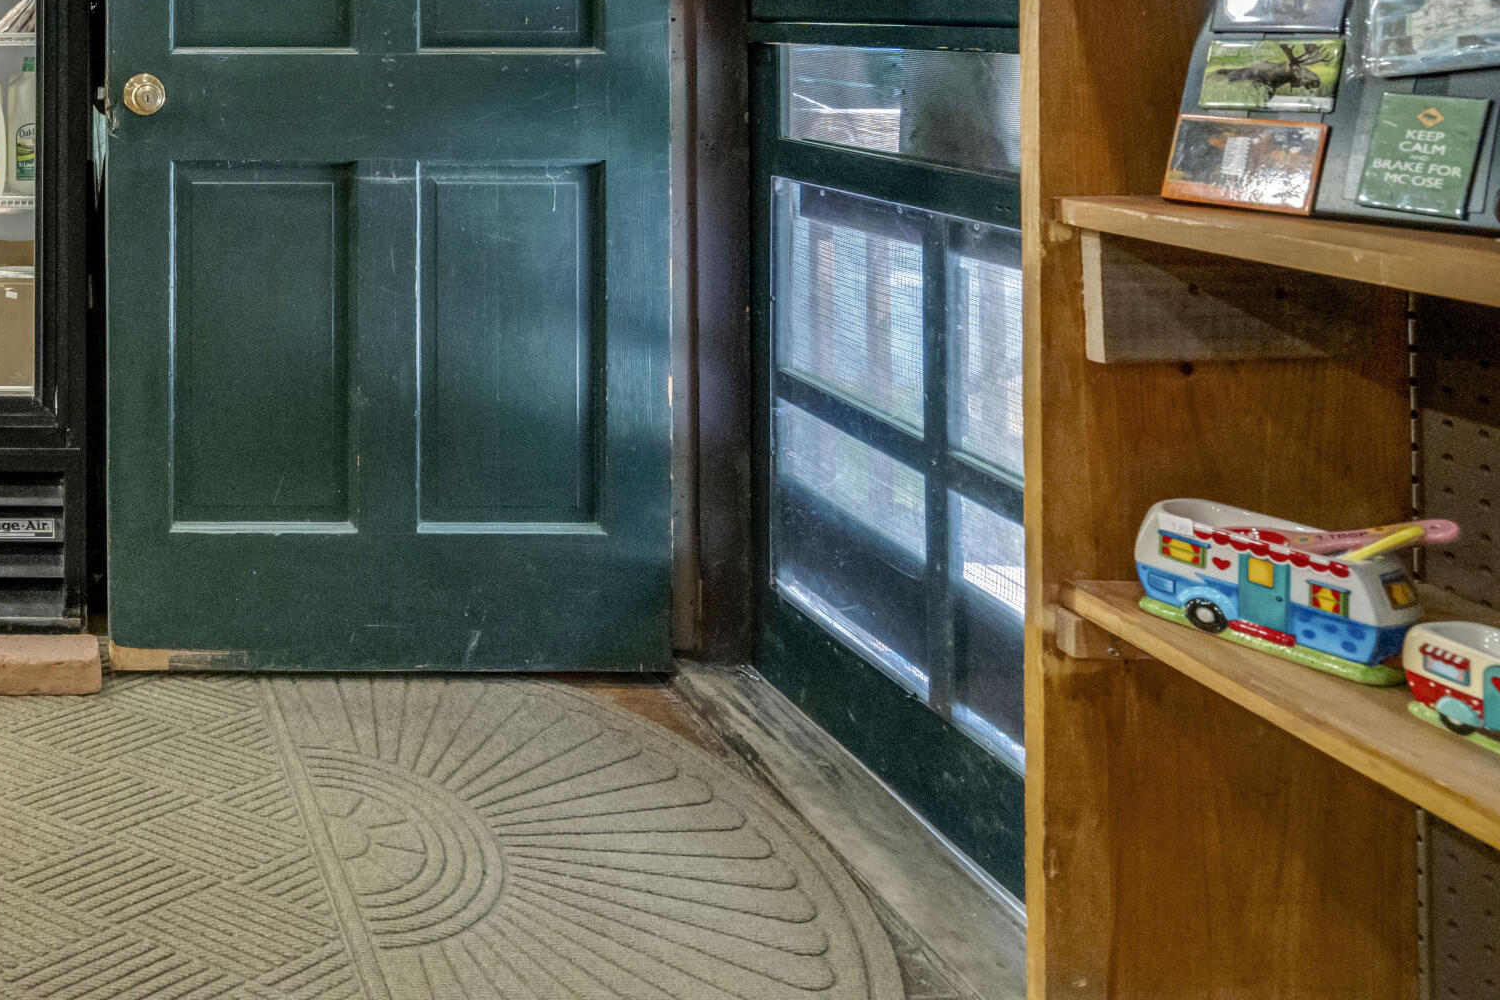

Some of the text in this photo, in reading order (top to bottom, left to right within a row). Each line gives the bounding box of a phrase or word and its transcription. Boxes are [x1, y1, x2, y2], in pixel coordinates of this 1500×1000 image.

[1405, 129, 1445, 142] KEEP
[1399, 141, 1446, 155] CALM
[1372, 158, 1461, 178] BRAKE FOR
